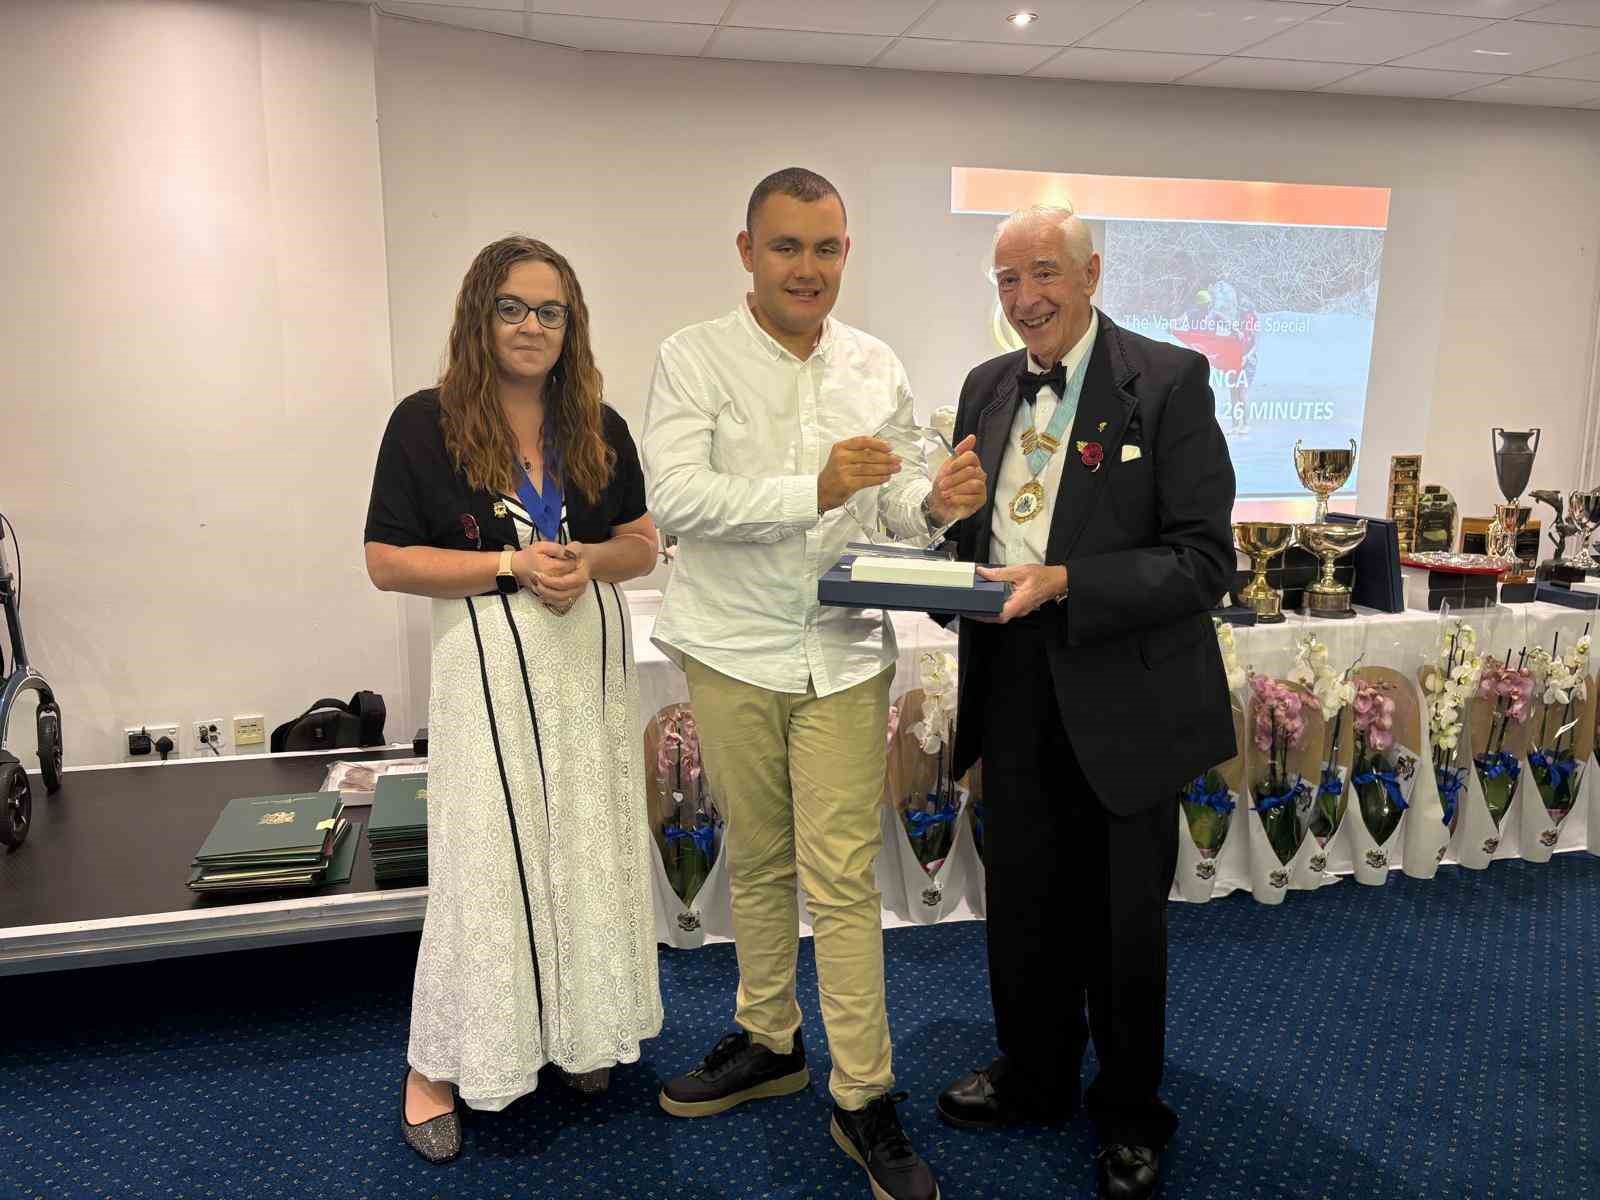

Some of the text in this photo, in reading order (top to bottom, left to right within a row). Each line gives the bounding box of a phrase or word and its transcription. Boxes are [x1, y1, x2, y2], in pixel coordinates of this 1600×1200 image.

[1124, 314, 1149, 329] The
[1152, 316, 1177, 330] Van
[1265, 318, 1311, 335] Special
[1224, 401, 1334, 420] 26 MINUTES
